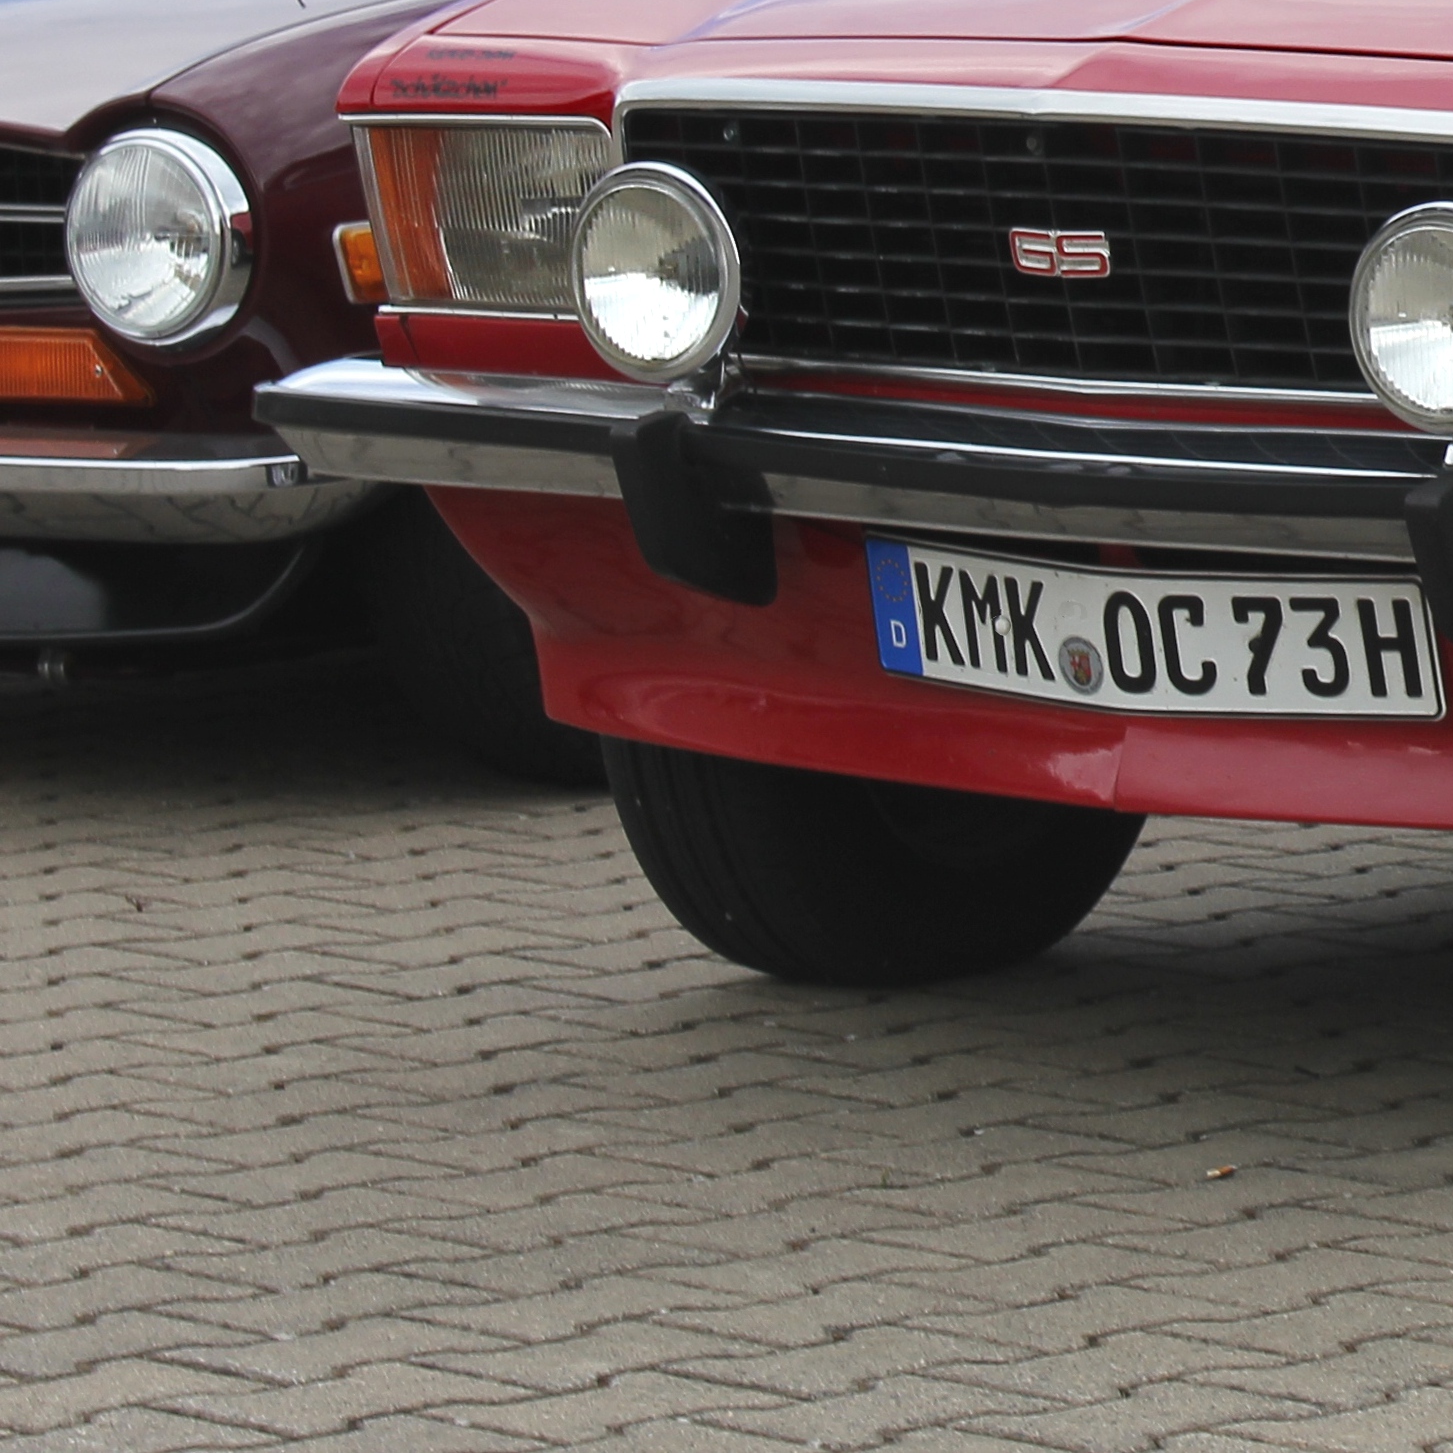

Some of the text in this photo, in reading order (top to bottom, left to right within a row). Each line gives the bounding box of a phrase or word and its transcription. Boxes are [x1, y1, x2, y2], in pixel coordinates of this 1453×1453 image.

[1009, 227, 1110, 278] GS
[890, 619, 907, 649] D
[914, 561, 1056, 681] KMK
